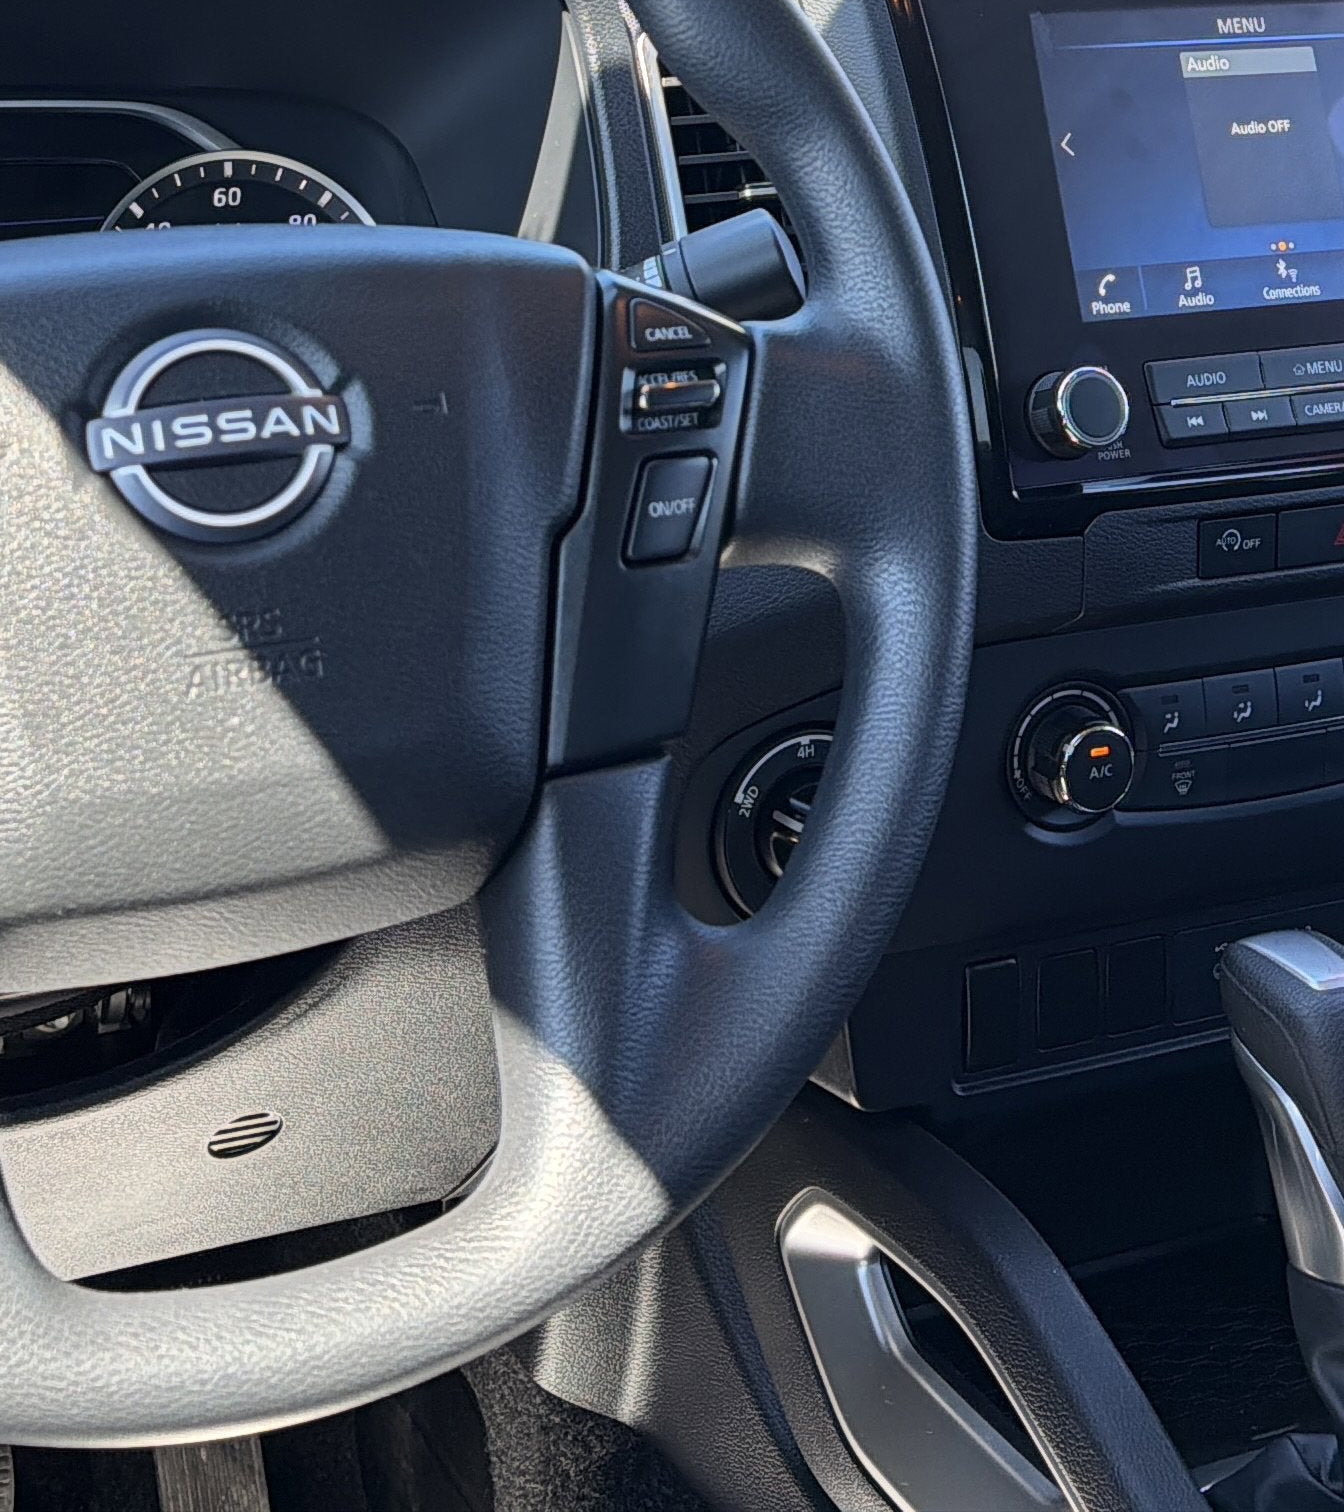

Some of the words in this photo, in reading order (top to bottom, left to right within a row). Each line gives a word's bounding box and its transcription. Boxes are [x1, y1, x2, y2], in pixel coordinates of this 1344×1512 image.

[1217, 16, 1266, 34] MENU
[1187, 55, 1230, 72] Audio
[1231, 120, 1266, 136] Audio
[1268, 118, 1291, 134] OFF
[213, 187, 241, 207] 60
[1178, 292, 1215, 308] Audio
[1263, 283, 1321, 300] Connections
[1091, 299, 1131, 315] Phone
[645, 325, 693, 342] CANCEL
[1307, 360, 1343, 375] MENU
[1186, 372, 1227, 387] AUDIO
[638, 412, 699, 431] COAST/SET
[101, 404, 341, 459] NISSAN
[1098, 449, 1131, 461] POWER
[649, 498, 697, 518] ON/OFF
[1243, 539, 1261, 550] OFF
[797, 744, 815, 759] 4H
[1089, 764, 1113, 780] A/C
[1171, 770, 1195, 780] FRONT
[1016, 777, 1032, 801] OFF
[738, 785, 759, 819] 2WD
